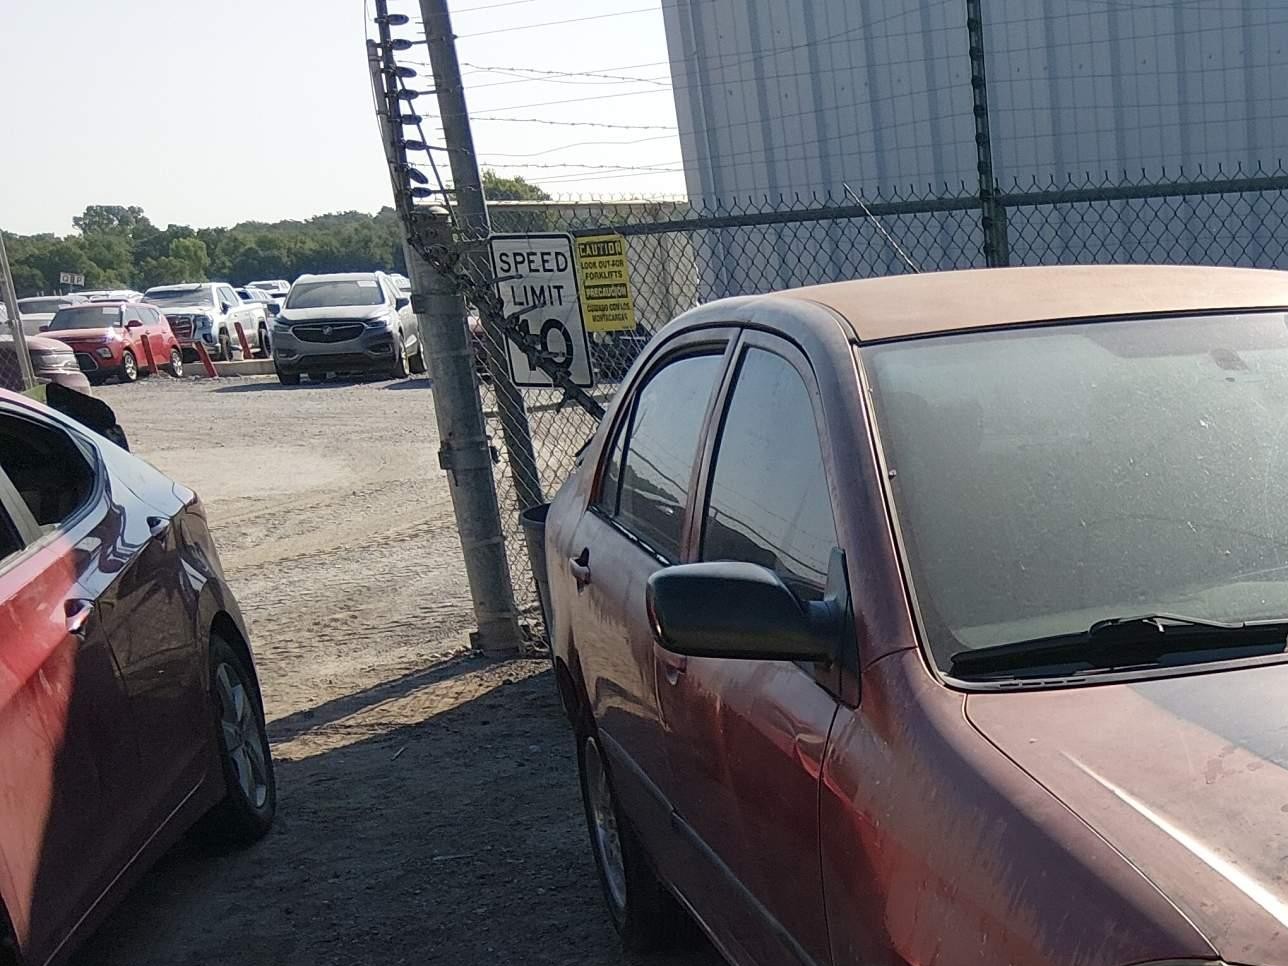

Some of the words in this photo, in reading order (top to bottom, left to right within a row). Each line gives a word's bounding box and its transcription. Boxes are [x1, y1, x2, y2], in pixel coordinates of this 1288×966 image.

[578, 241, 622, 256] CAUTION
[499, 252, 568, 273] SPEED
[581, 261, 598, 270] LOOK
[599, 260, 610, 269] OUT
[585, 271, 623, 280] FORKLIFTS
[511, 285, 564, 306] LIMIT
